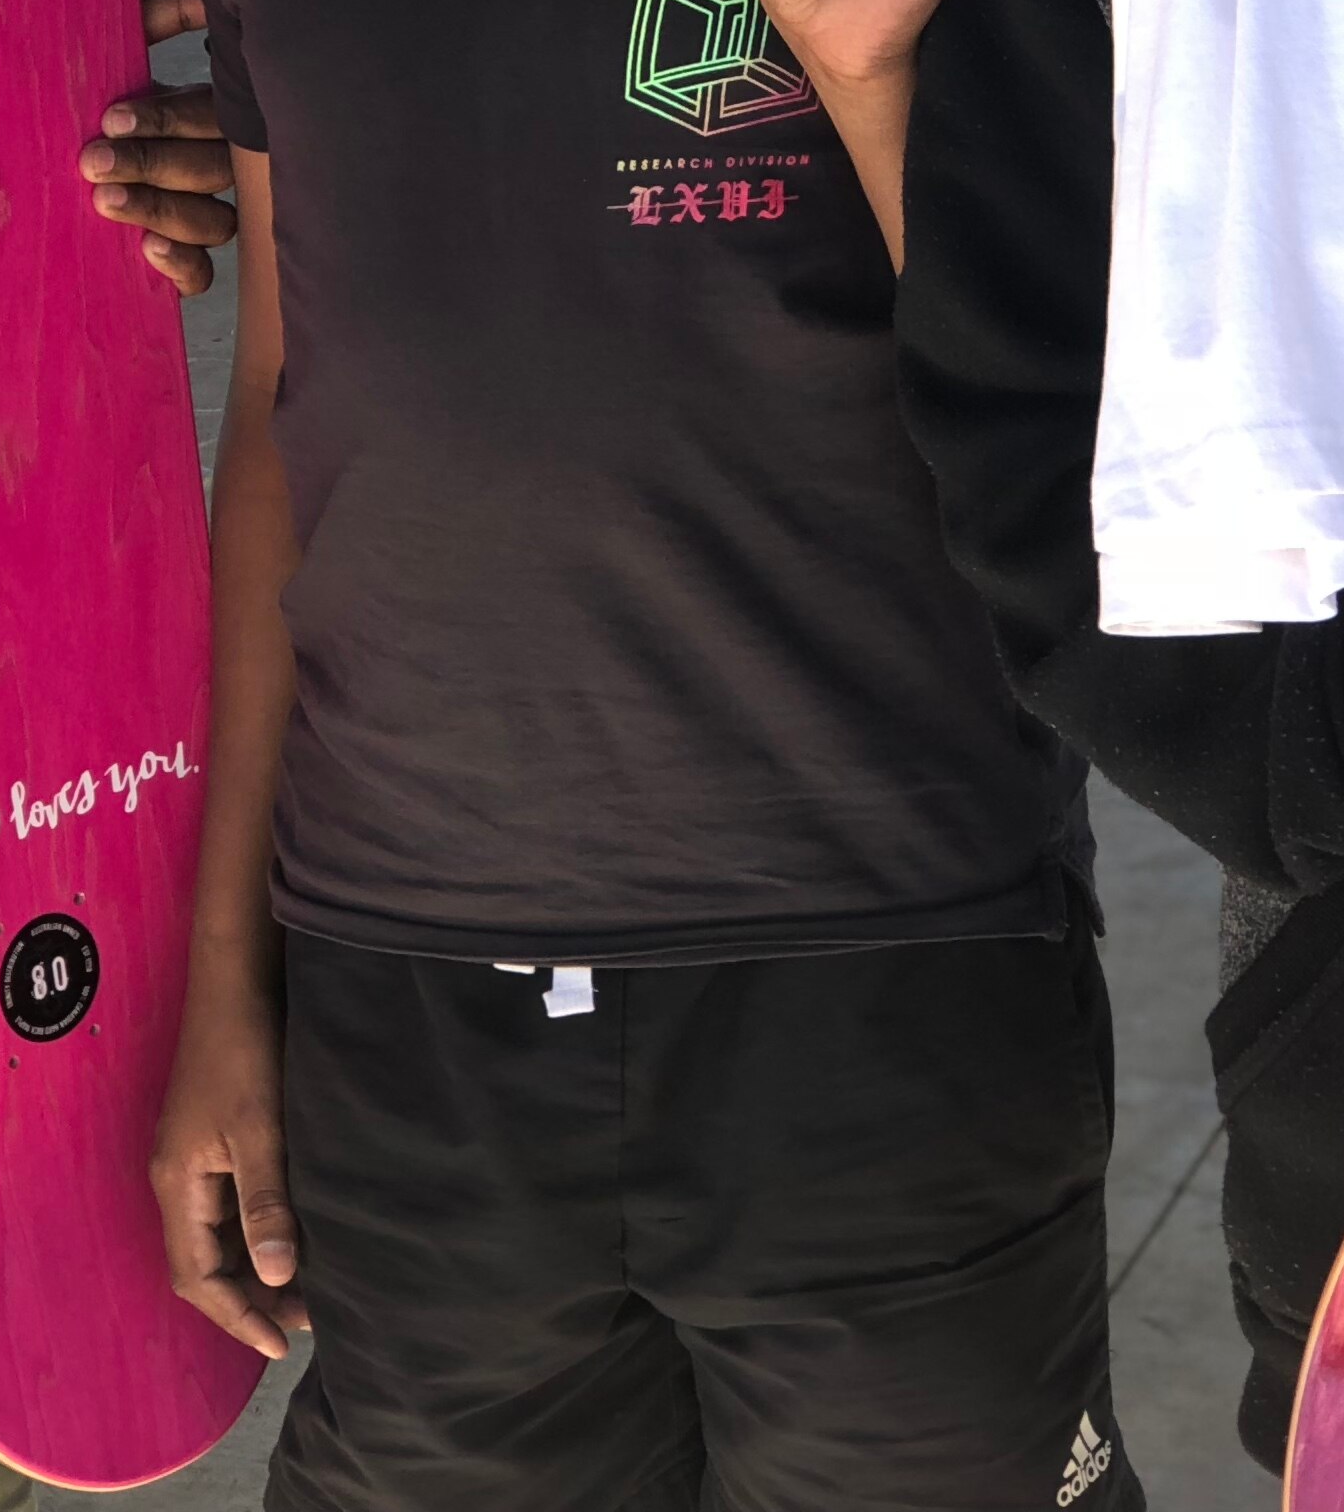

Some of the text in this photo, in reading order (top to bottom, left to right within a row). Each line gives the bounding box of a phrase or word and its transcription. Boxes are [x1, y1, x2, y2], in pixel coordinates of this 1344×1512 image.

[616, 154, 811, 172] RESEARCH DIVISION
[10, 769, 100, 840] loves
[1056, 1439, 1112, 1507] adidas
